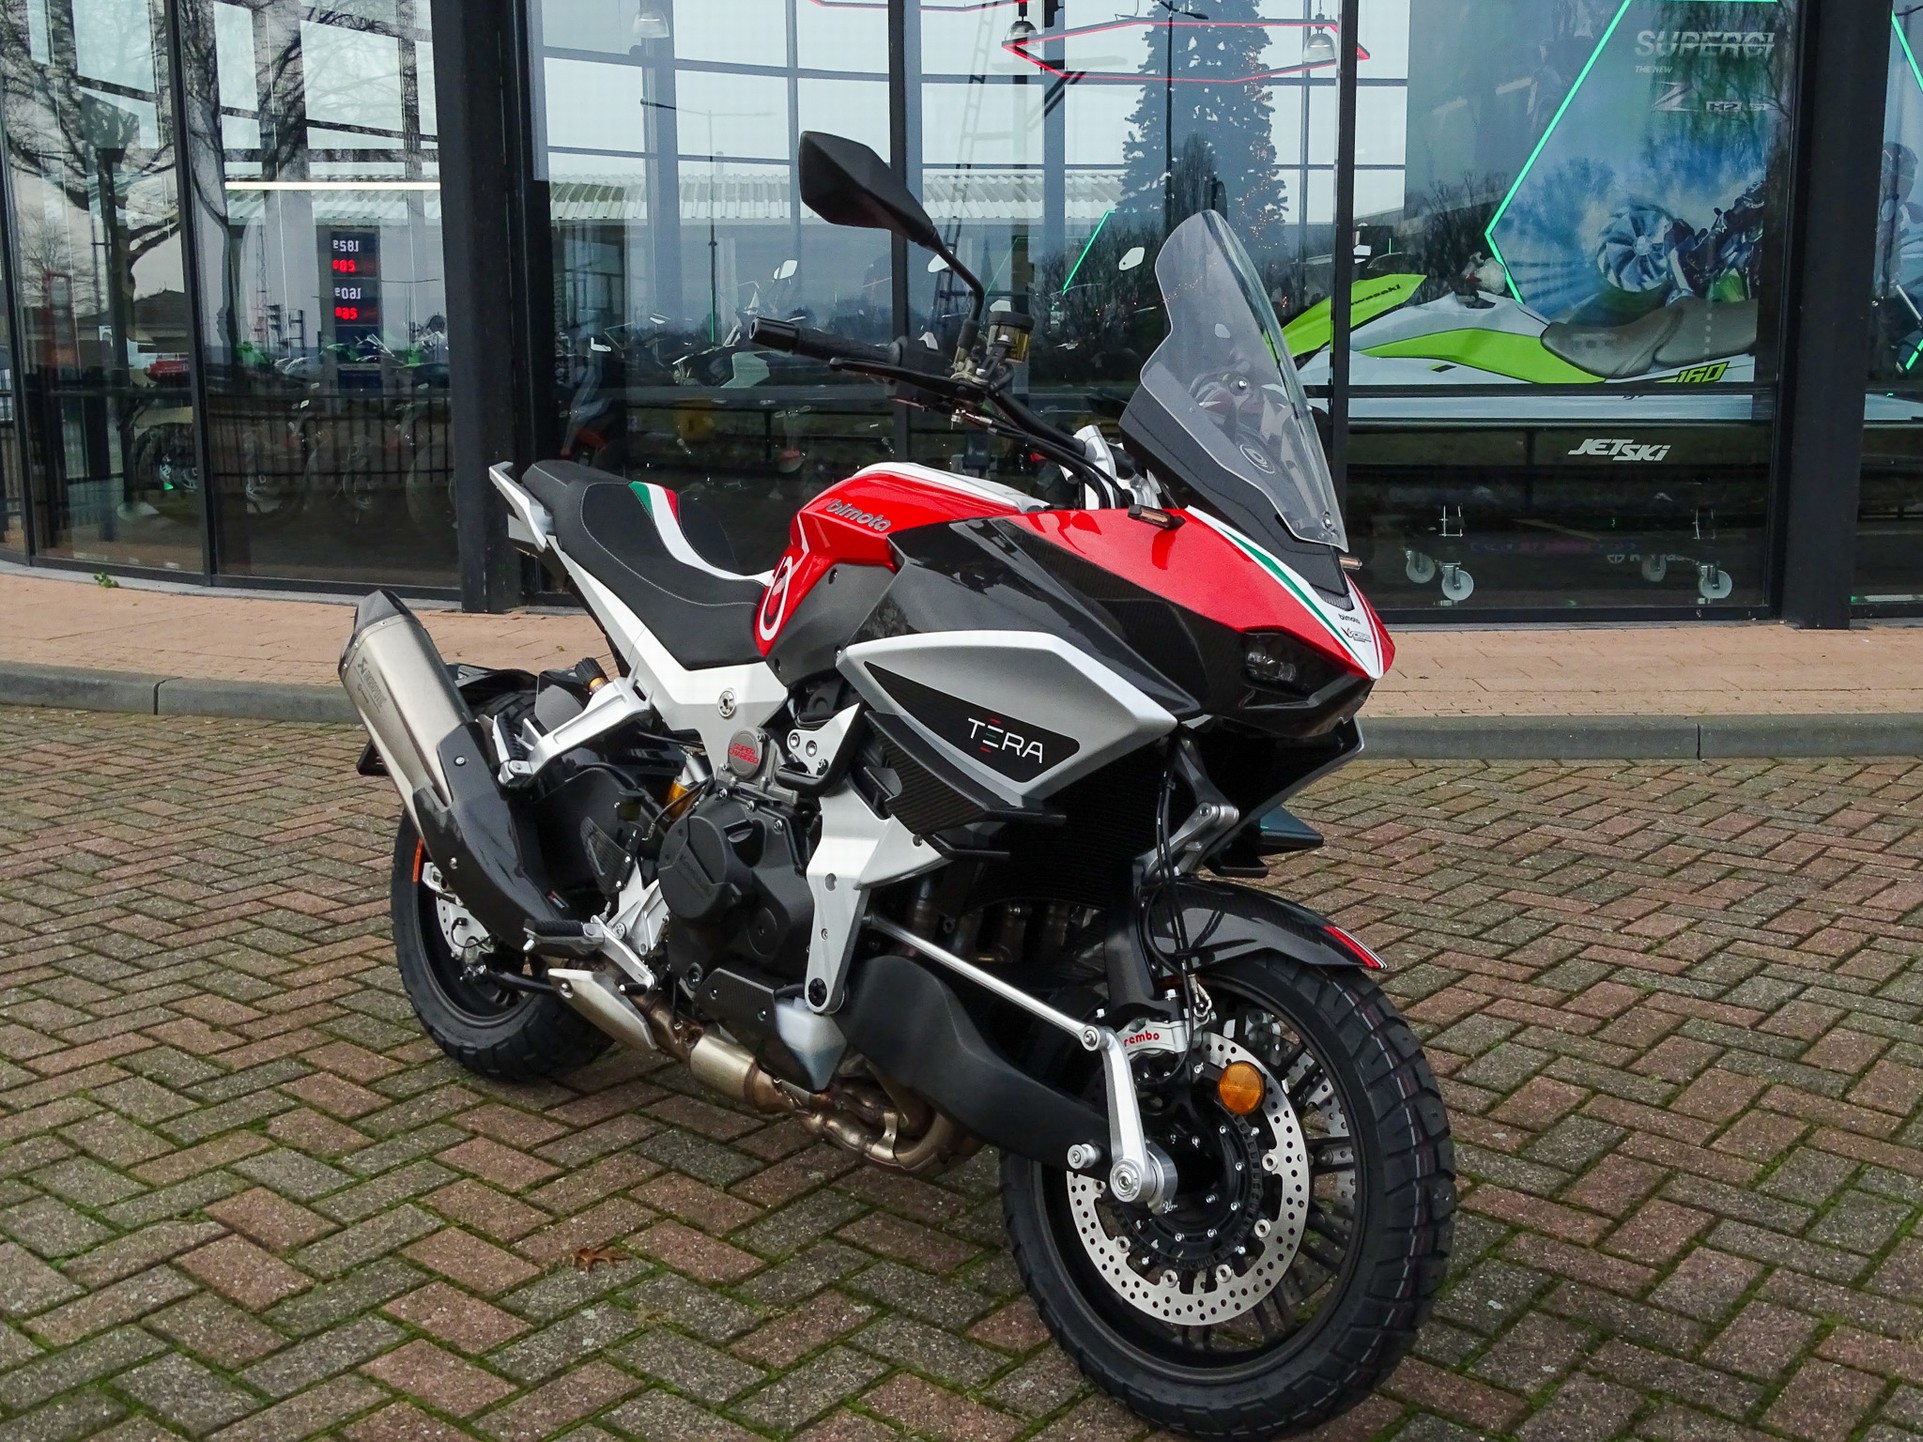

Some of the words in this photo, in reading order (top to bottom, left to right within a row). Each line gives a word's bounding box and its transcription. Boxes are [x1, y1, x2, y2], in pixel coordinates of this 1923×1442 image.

[1676, 361, 1730, 384] 160
[826, 499, 892, 532] bimota
[967, 716, 1044, 764] TERA
[1123, 1029, 1160, 1047] rembo
